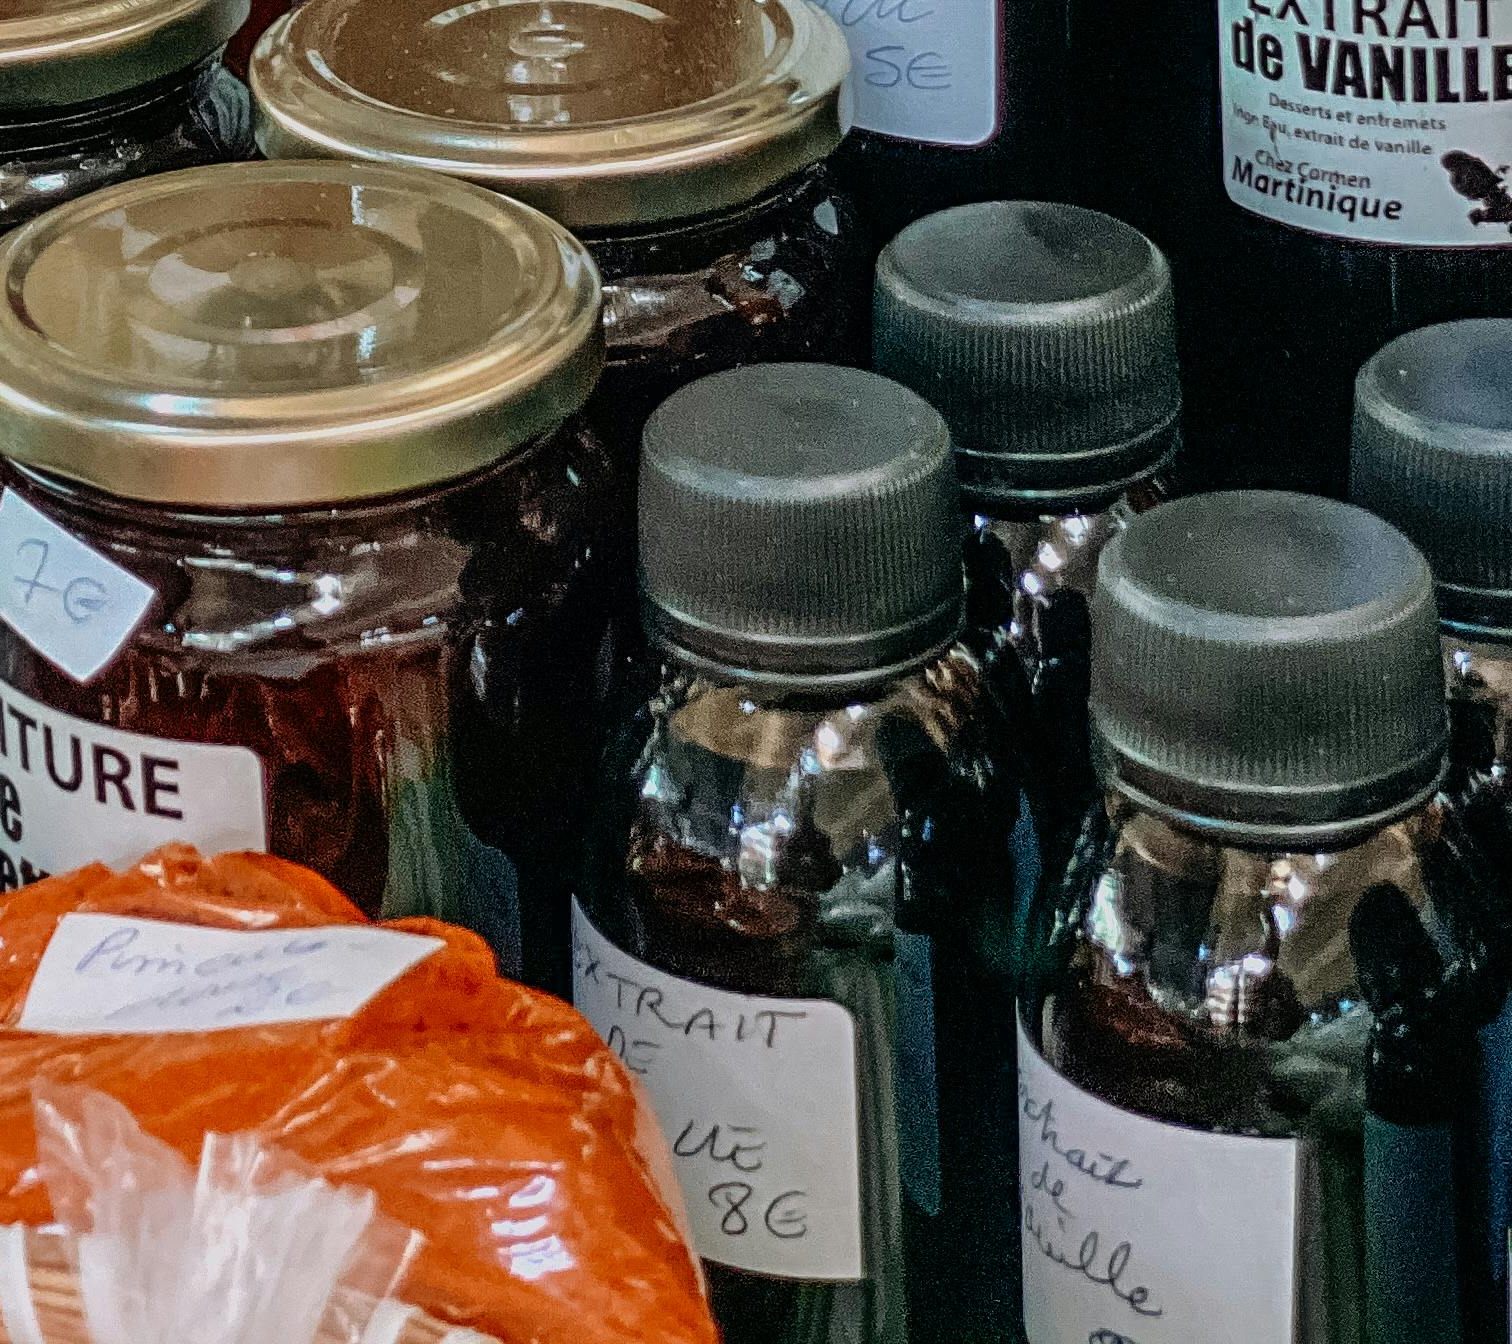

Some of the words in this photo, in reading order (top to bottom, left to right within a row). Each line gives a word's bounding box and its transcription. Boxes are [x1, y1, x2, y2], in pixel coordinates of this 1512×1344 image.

[1231, 16, 1284, 82] de
[1269, 92, 1332, 120] Desserts
[1336, 108, 1352, 123] et
[1357, 113, 1447, 131] entremets
[1294, 127, 1344, 147] extrait
[1349, 136, 1369, 150] de
[1375, 139, 1433, 155] vanille
[1255, 149, 1292, 173] Chez
[1232, 155, 1402, 222] Martinique
